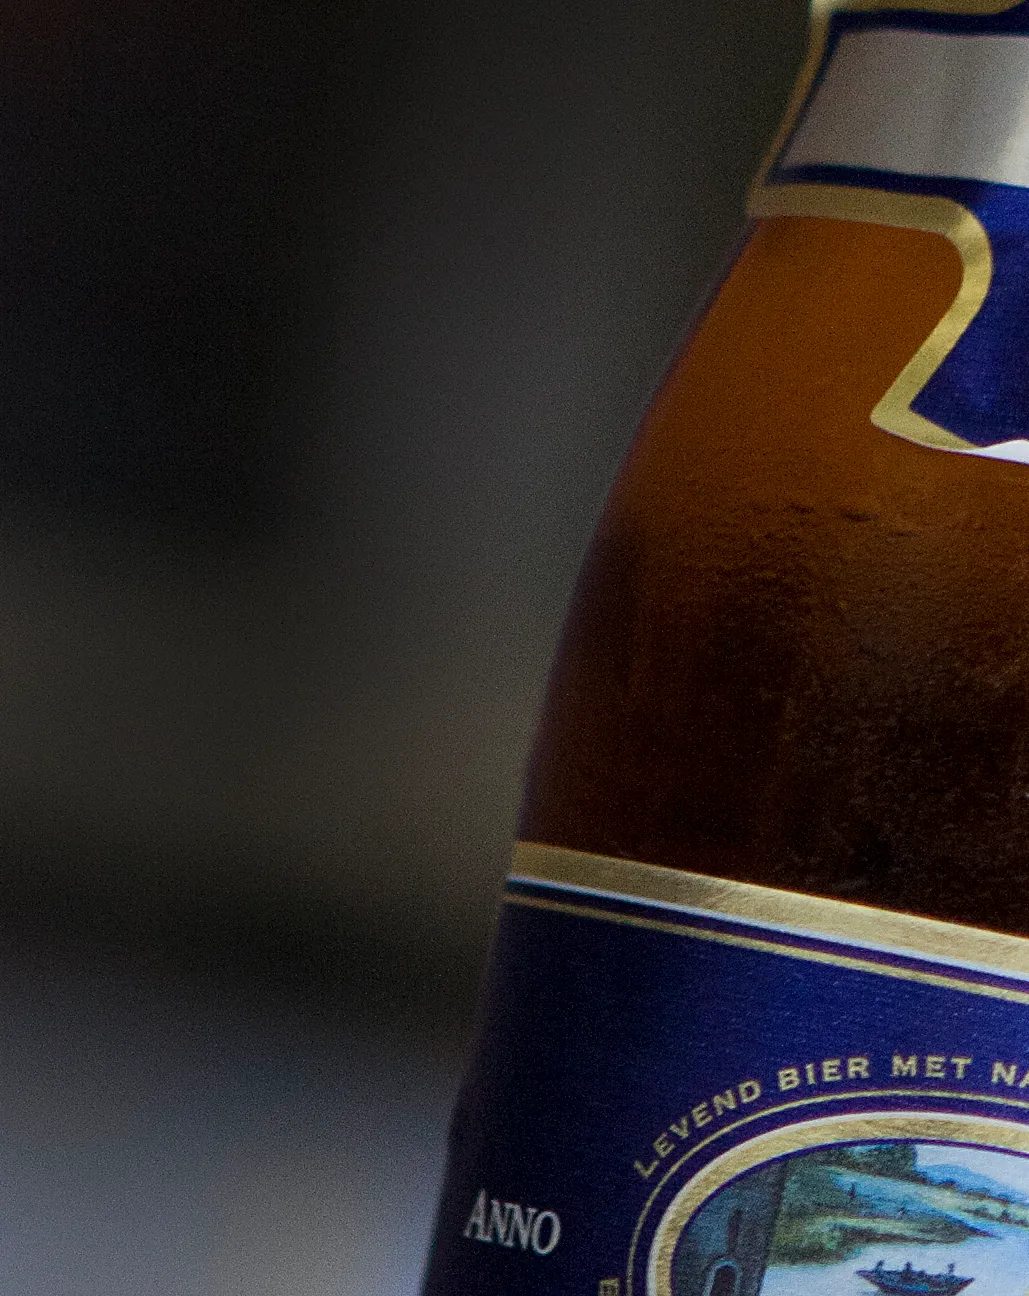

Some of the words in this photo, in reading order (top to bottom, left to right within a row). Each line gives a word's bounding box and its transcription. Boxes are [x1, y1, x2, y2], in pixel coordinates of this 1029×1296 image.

[633, 1079, 762, 1179] LEVEND
[777, 1056, 871, 1092] BIER
[890, 1055, 973, 1080] MET
[463, 1187, 562, 1256] ANNO
